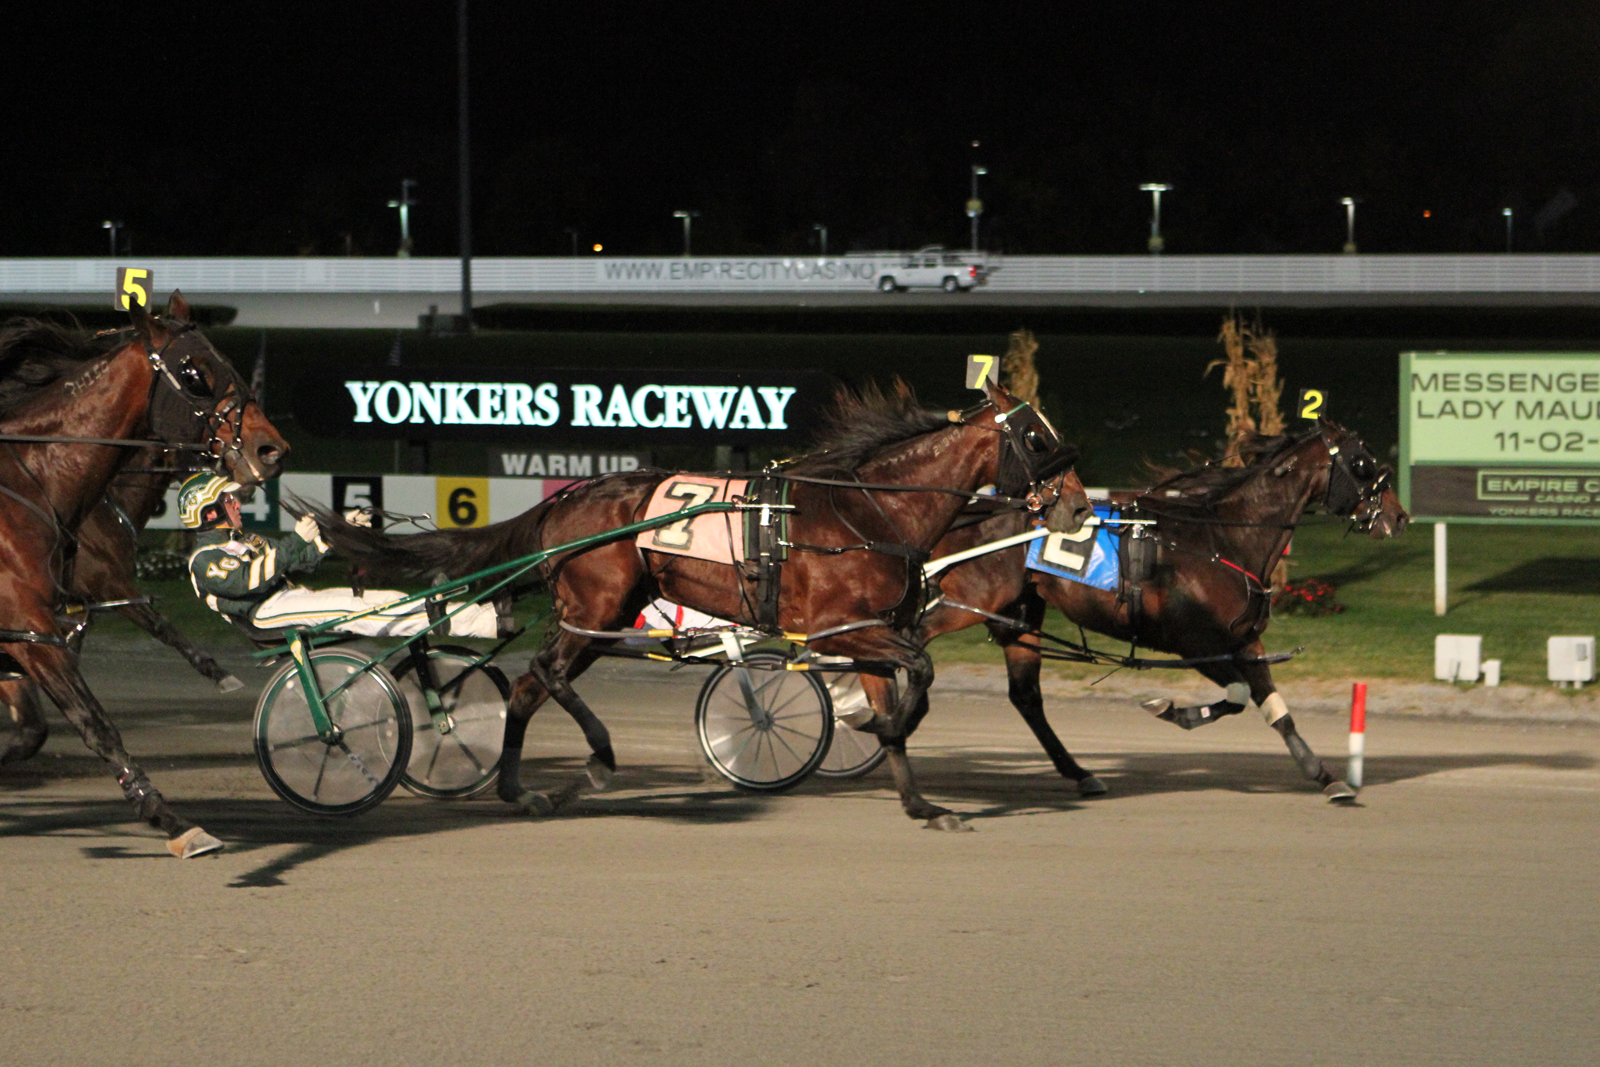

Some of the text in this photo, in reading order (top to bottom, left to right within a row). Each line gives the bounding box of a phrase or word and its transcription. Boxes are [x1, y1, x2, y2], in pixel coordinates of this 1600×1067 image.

[121, 268, 148, 310] 5
[973, 355, 993, 389] 7
[1411, 373, 1599, 393] MESSENGE
[345, 380, 796, 430] YONKERS RACEWAY
[1301, 390, 1323, 420] 2
[1417, 401, 1600, 420] LADY MAU
[1494, 432, 1599, 452] 11-02-
[502, 454, 639, 477] WARM UP
[1487, 479, 1578, 493] EMPIRE
[448, 488, 478, 526] 6
[655, 482, 718, 549] 7
[1042, 525, 1094, 571] 2
[206, 557, 241, 580] YG
